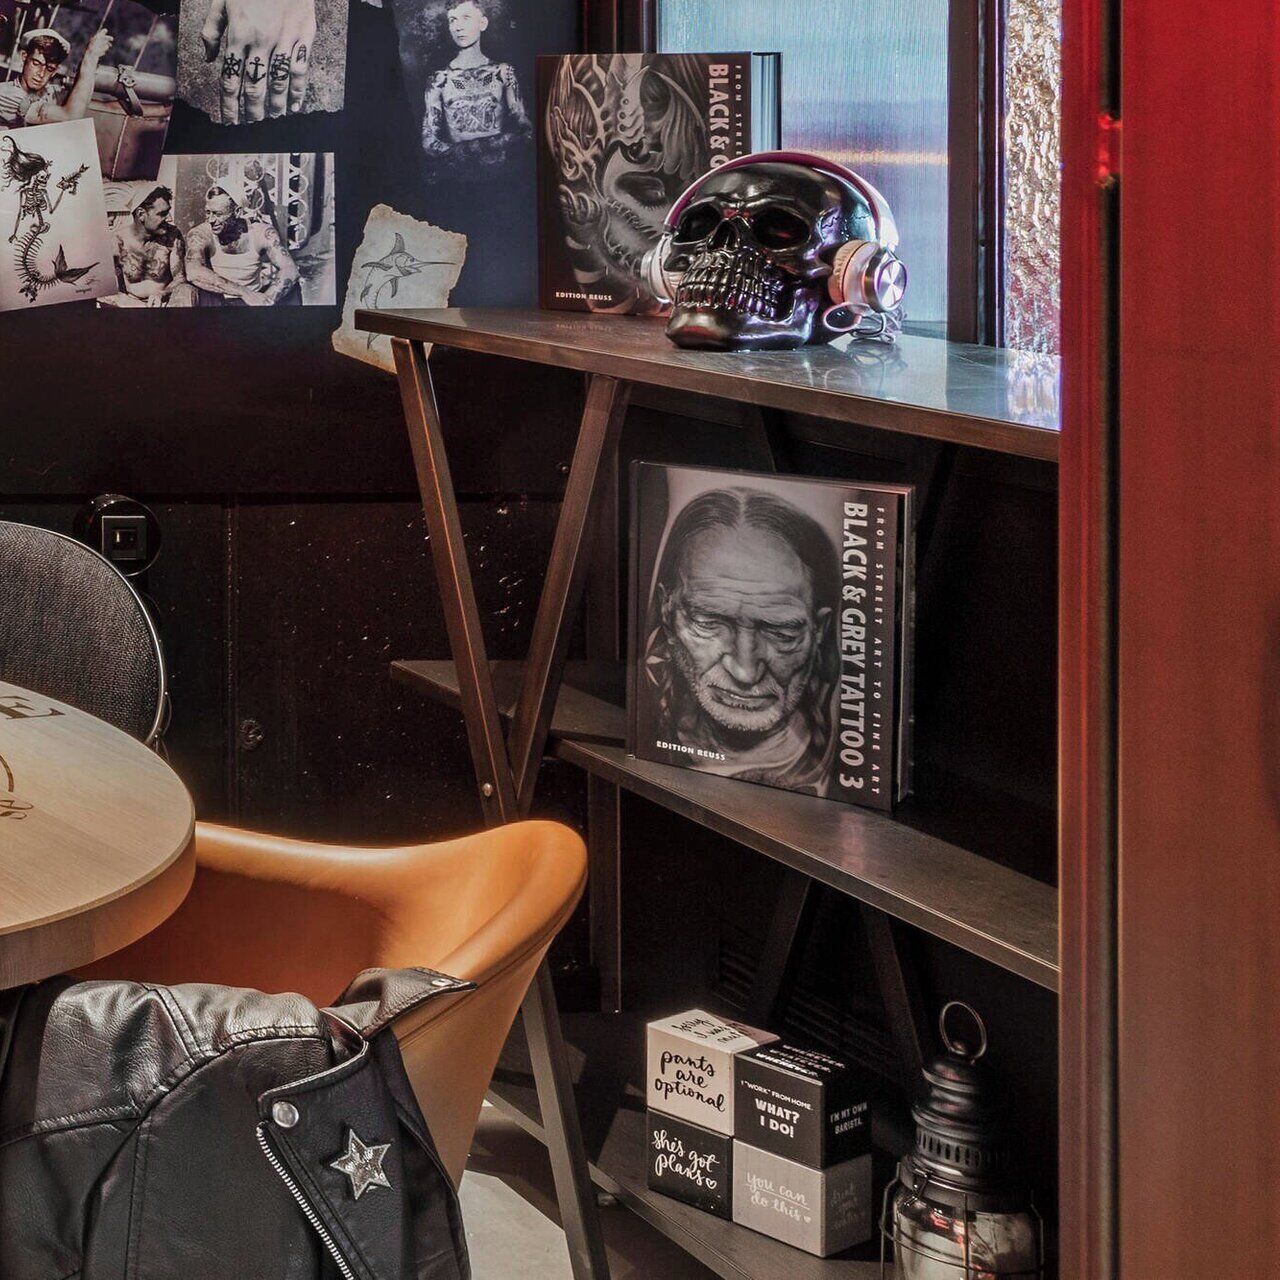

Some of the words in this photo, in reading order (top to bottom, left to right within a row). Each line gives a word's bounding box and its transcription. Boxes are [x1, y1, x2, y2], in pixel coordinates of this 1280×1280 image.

[708, 64, 730, 131] BLACK
[709, 135, 730, 150] &
[555, 291, 587, 300] EDITION
[588, 293, 612, 301] REUSS
[842, 502, 868, 581] BLACK
[876, 507, 885, 550] FROM
[841, 585, 867, 604] &
[874, 563, 883, 624] STREET
[841, 608, 866, 668] GREY
[873, 637, 882, 668] ART
[873, 681, 882, 699] TO
[840, 673, 865, 767] TATTOO
[872, 712, 881, 750] FINE
[656, 740, 694, 754] EDITION
[697, 749, 726, 761] REUSS
[839, 773, 864, 790] 3
[871, 763, 880, 794] ART
[660, 1051, 716, 1077] pants
[676, 1069, 708, 1088] are
[655, 1078, 725, 1112] optional
[745, 1080, 771, 1095] "WORK"
[771, 1091, 791, 1103] FROM
[755, 1098, 800, 1124] WHAT?
[852, 1102, 868, 1115] OWN
[760, 1115, 765, 1127] I
[769, 1118, 795, 1138] DO!
[651, 1129, 686, 1158] she's
[688, 1150, 720, 1173] got
[655, 1153, 704, 1187] plans
[746, 1172, 775, 1193] you
[779, 1186, 808, 1205] can
[750, 1192, 770, 1208] do
[772, 1198, 801, 1222] this
